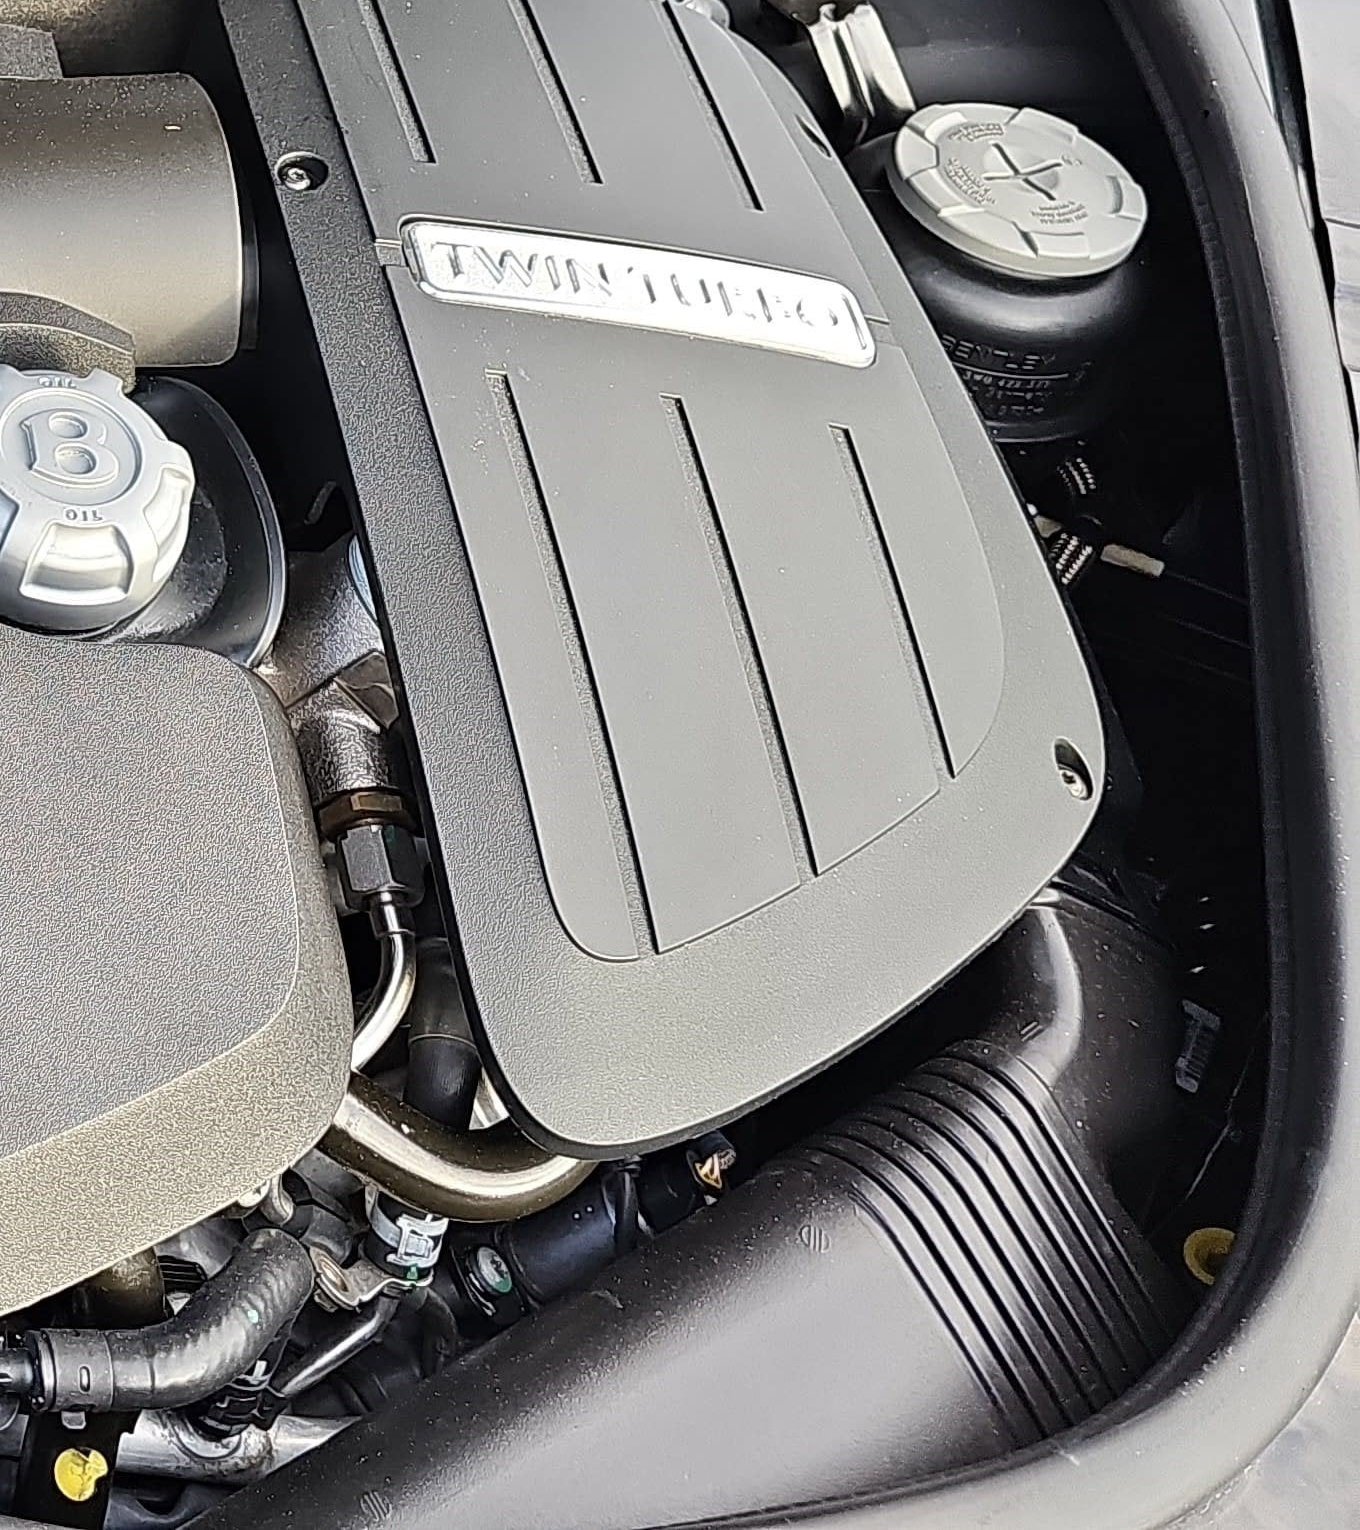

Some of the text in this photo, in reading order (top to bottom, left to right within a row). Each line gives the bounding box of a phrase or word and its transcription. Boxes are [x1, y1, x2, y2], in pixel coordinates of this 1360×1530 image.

[430, 241, 613, 298] TWIN
[20, 408, 120, 488] B
[65, 509, 103, 522] OIL
